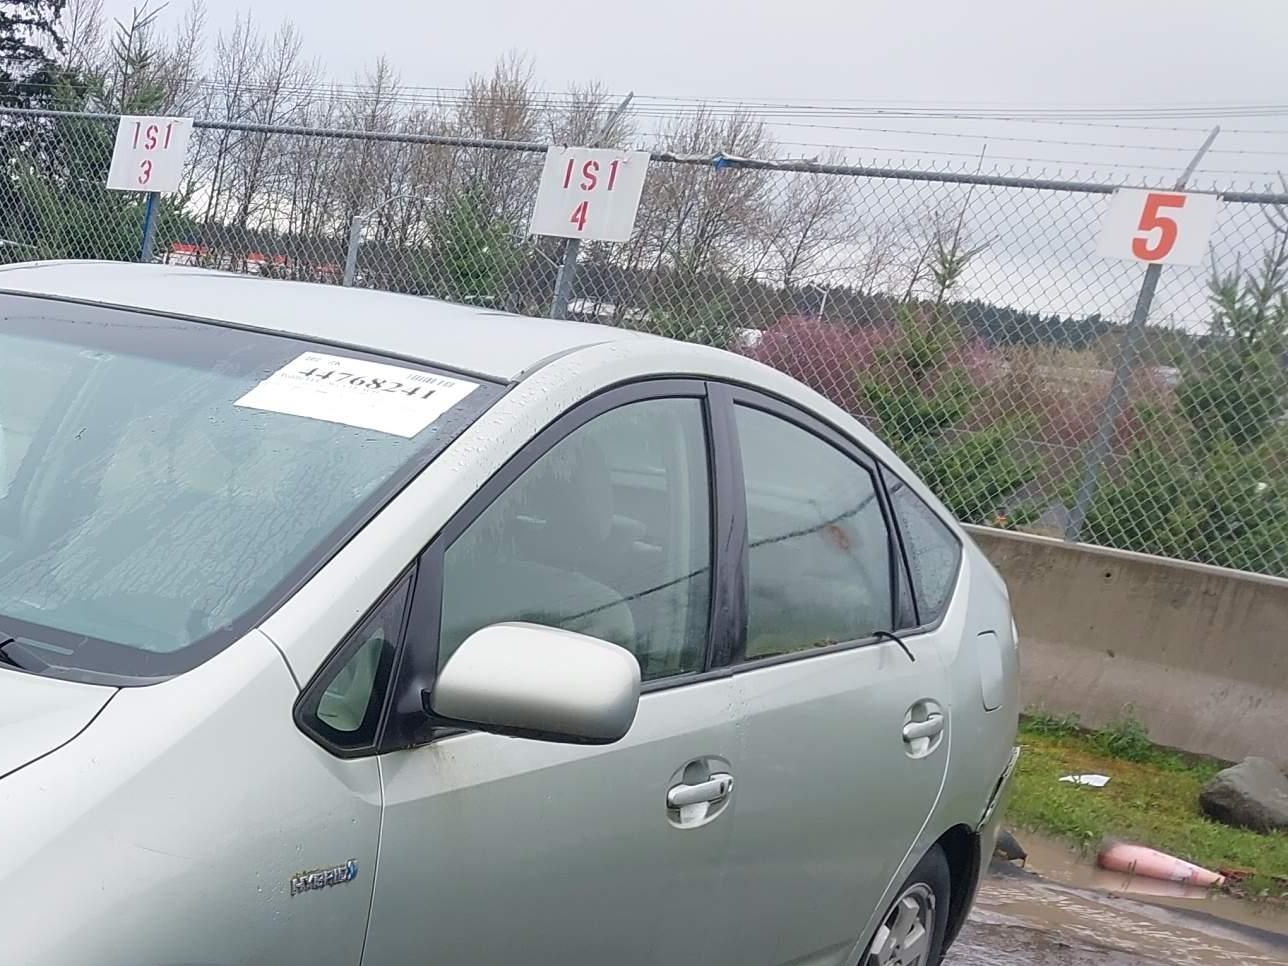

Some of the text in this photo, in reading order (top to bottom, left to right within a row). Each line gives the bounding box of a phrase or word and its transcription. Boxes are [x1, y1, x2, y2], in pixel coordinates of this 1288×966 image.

[138, 160, 152, 184] 3
[570, 201, 588, 231] 4
[1132, 193, 1186, 261] 5
[297, 366, 438, 400] 44768241
[291, 866, 349, 896] HYBRID
